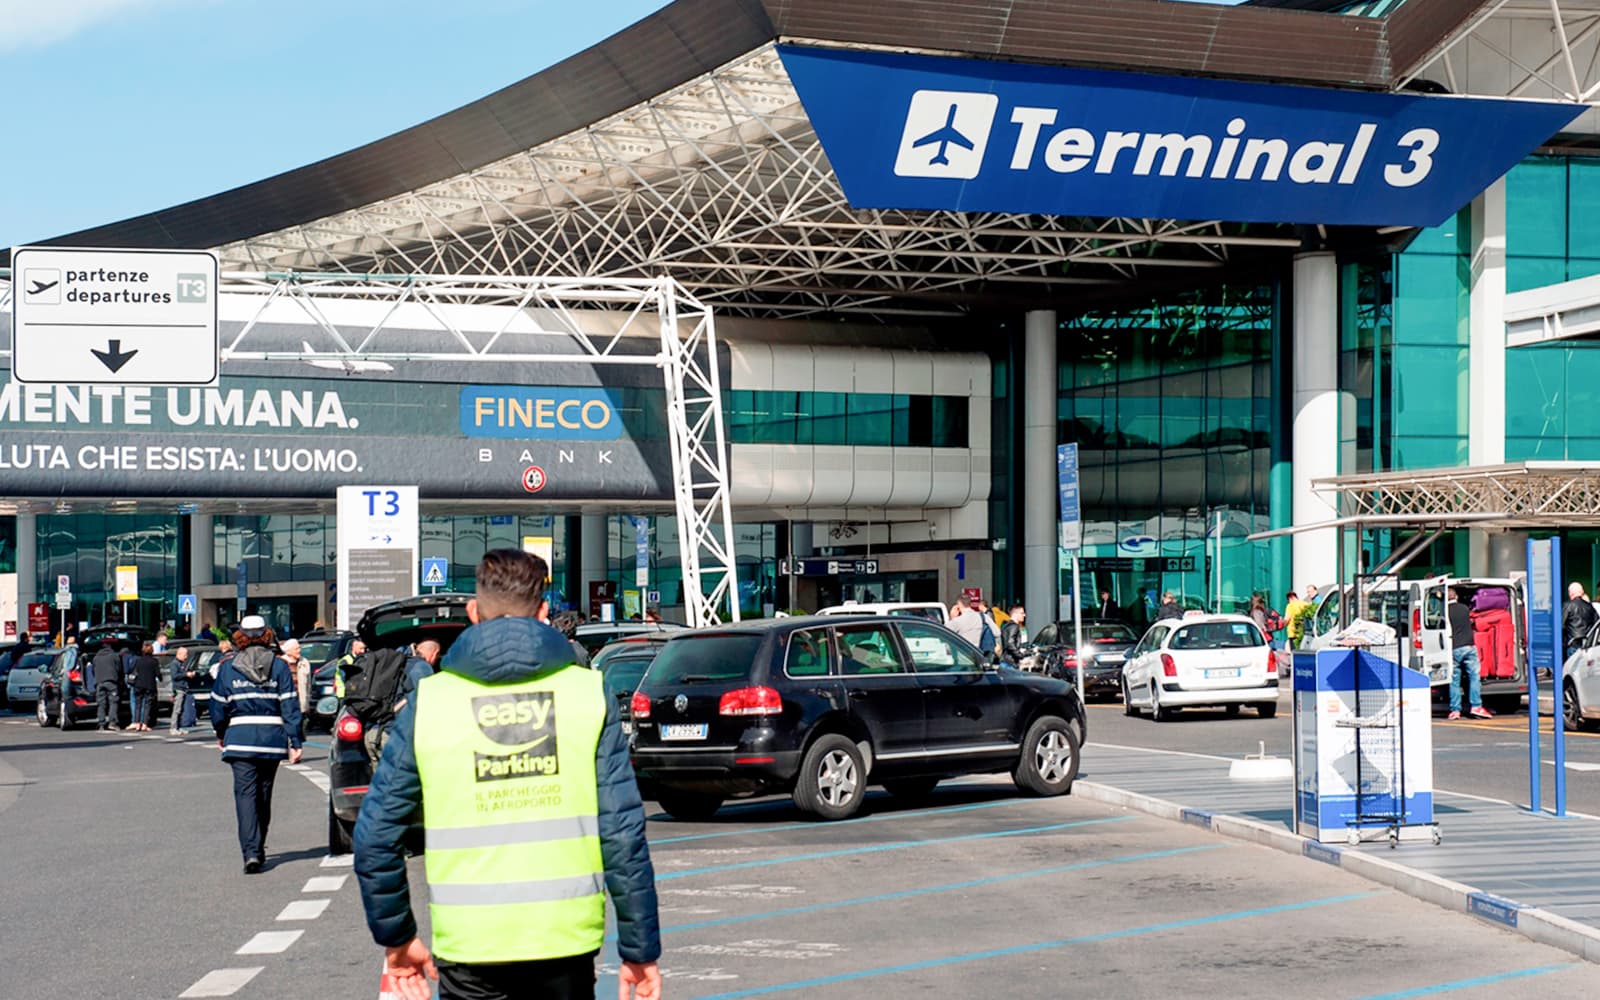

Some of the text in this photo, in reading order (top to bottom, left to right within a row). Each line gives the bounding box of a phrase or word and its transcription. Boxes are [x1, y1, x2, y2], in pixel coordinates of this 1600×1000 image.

[1009, 106, 1440, 188] Terminal 3
[66, 268, 149, 284] partenze
[178, 280, 207, 298] T3
[67, 283, 172, 305] departures
[167, 387, 360, 428] UMANA.
[475, 397, 611, 430] FINECO
[78, 446, 138, 471] CHE
[146, 447, 246, 472] ESISTA:
[254, 448, 363, 472] L’UOMO.
[362, 490, 400, 517] T3
[954, 553, 966, 580] 1
[478, 698, 553, 731] easy
[477, 754, 557, 778] Parking
[475, 784, 561, 801] IL PARCHEGGIO
[477, 796, 562, 812] IN AEROPORTO
